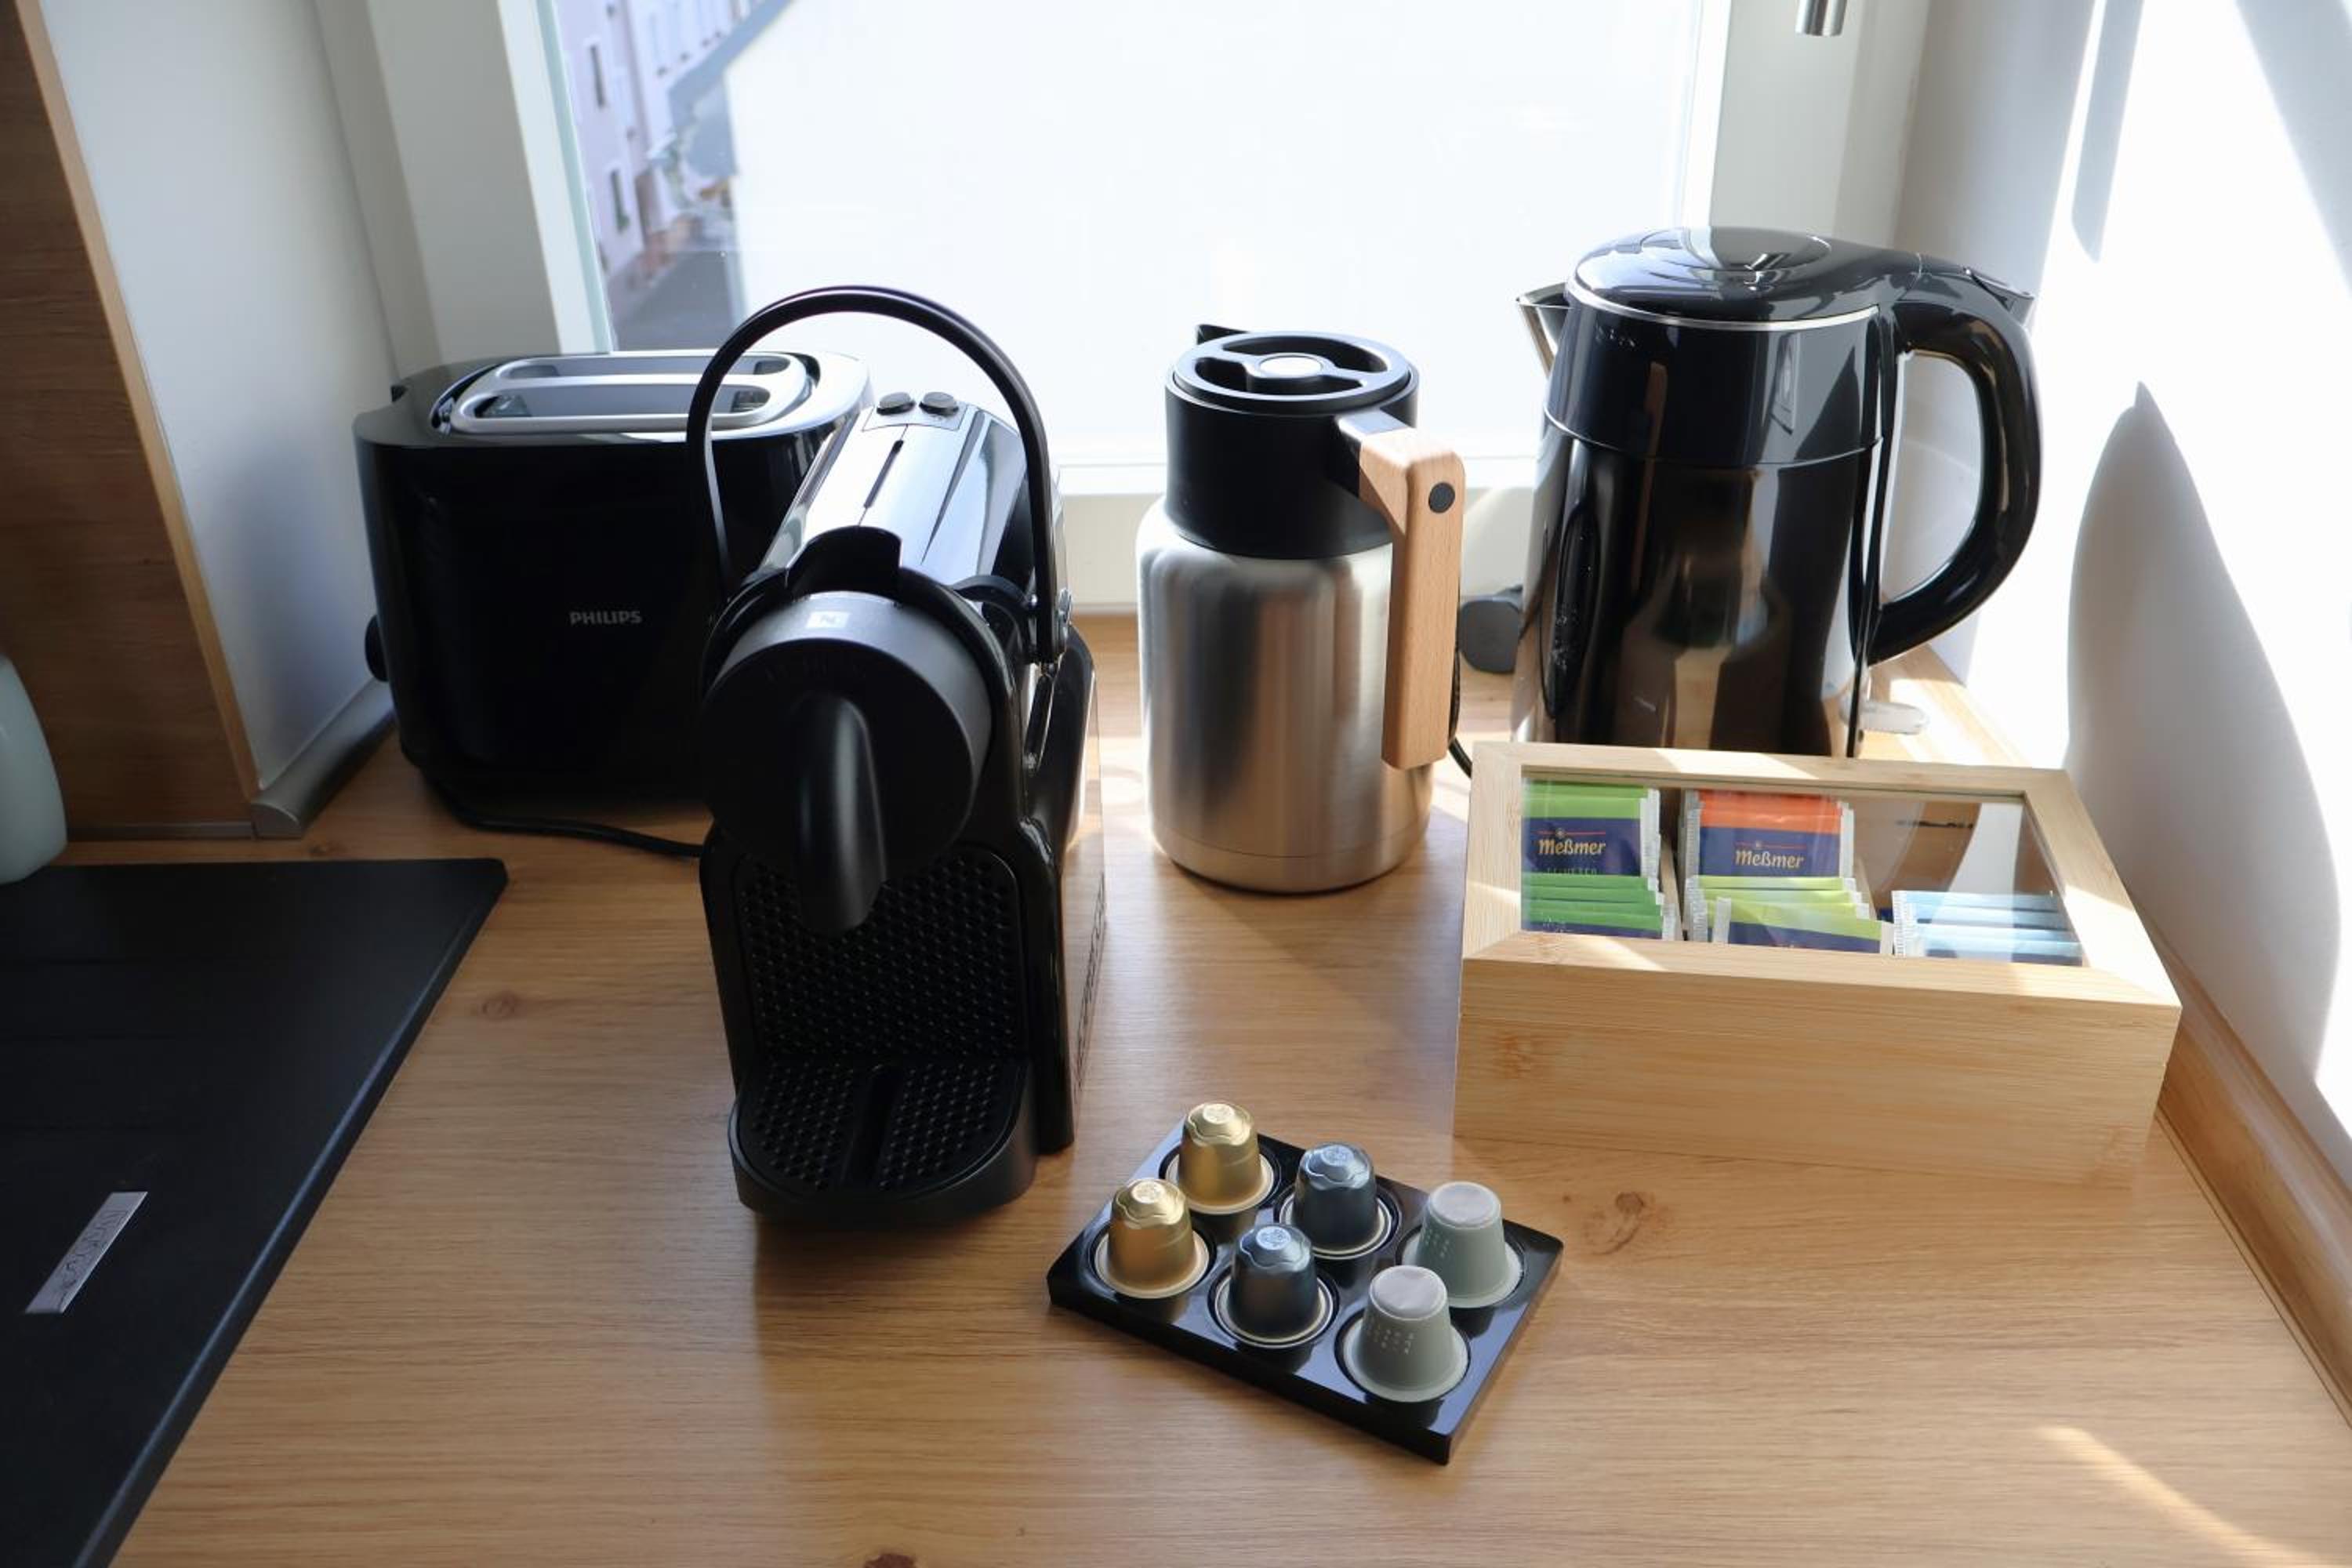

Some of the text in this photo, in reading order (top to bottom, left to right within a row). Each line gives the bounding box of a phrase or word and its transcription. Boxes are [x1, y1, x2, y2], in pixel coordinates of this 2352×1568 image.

[569, 610, 642, 625] PHILIPS
[1538, 839, 1606, 855] Meßmer
[1735, 850, 1805, 868] Meßmer
